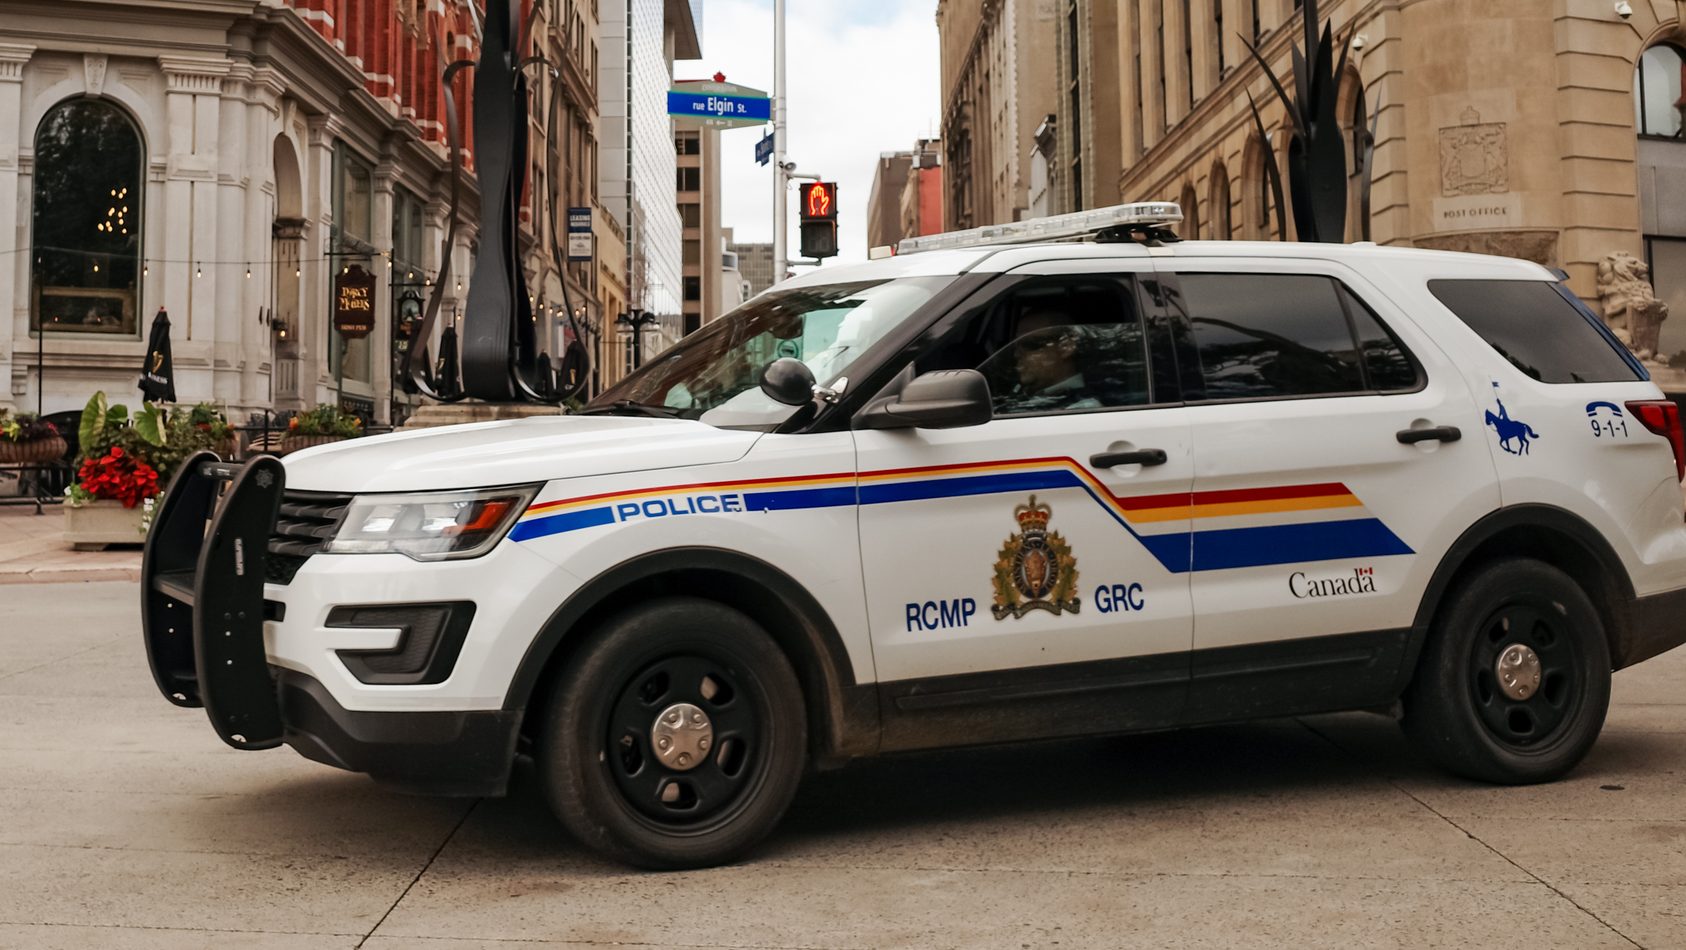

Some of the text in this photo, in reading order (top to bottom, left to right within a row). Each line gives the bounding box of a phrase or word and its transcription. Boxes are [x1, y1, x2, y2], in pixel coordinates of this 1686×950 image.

[692, 96, 747, 116] rue Elgin St.
[1444, 207, 1507, 218] POST OFFICE
[1591, 419, 1628, 438] 9-1-1
[617, 493, 740, 522] POLICE
[1288, 568, 1377, 599] Canada
[906, 598, 976, 632] RCMP
[1095, 582, 1145, 613] GRC
